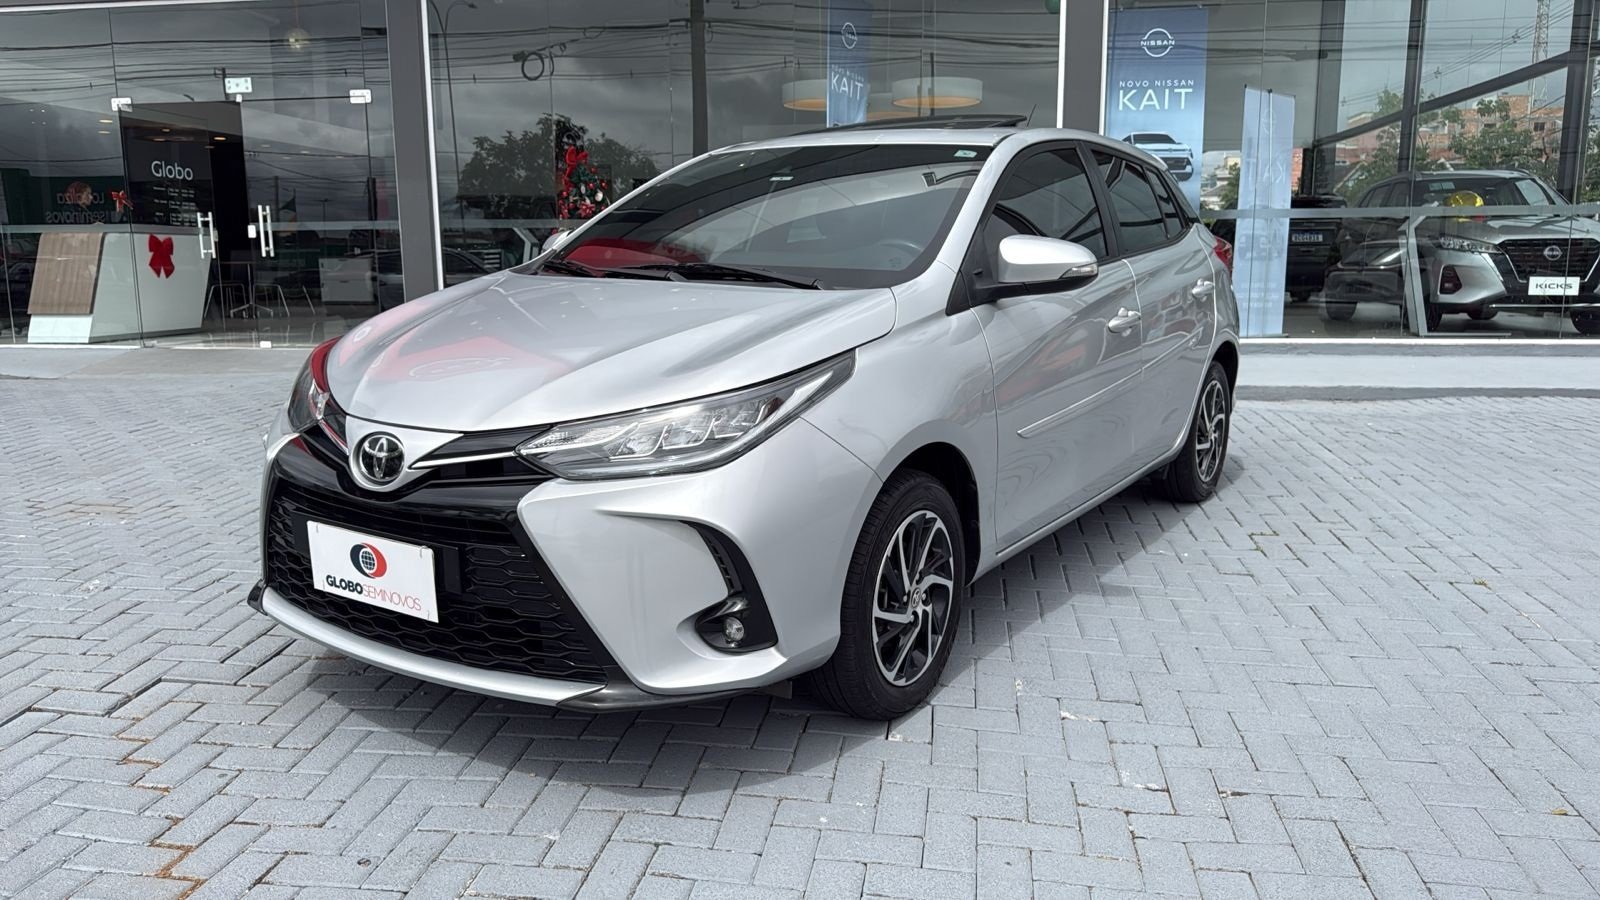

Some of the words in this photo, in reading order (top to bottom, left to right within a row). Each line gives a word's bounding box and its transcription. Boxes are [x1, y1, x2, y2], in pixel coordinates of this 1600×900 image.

[831, 70, 864, 101] KAIT
[1119, 80, 1149, 88] NOVO
[1154, 79, 1194, 87] NISSAN
[1118, 88, 1193, 111] KAIT
[151, 160, 194, 181] Globo
